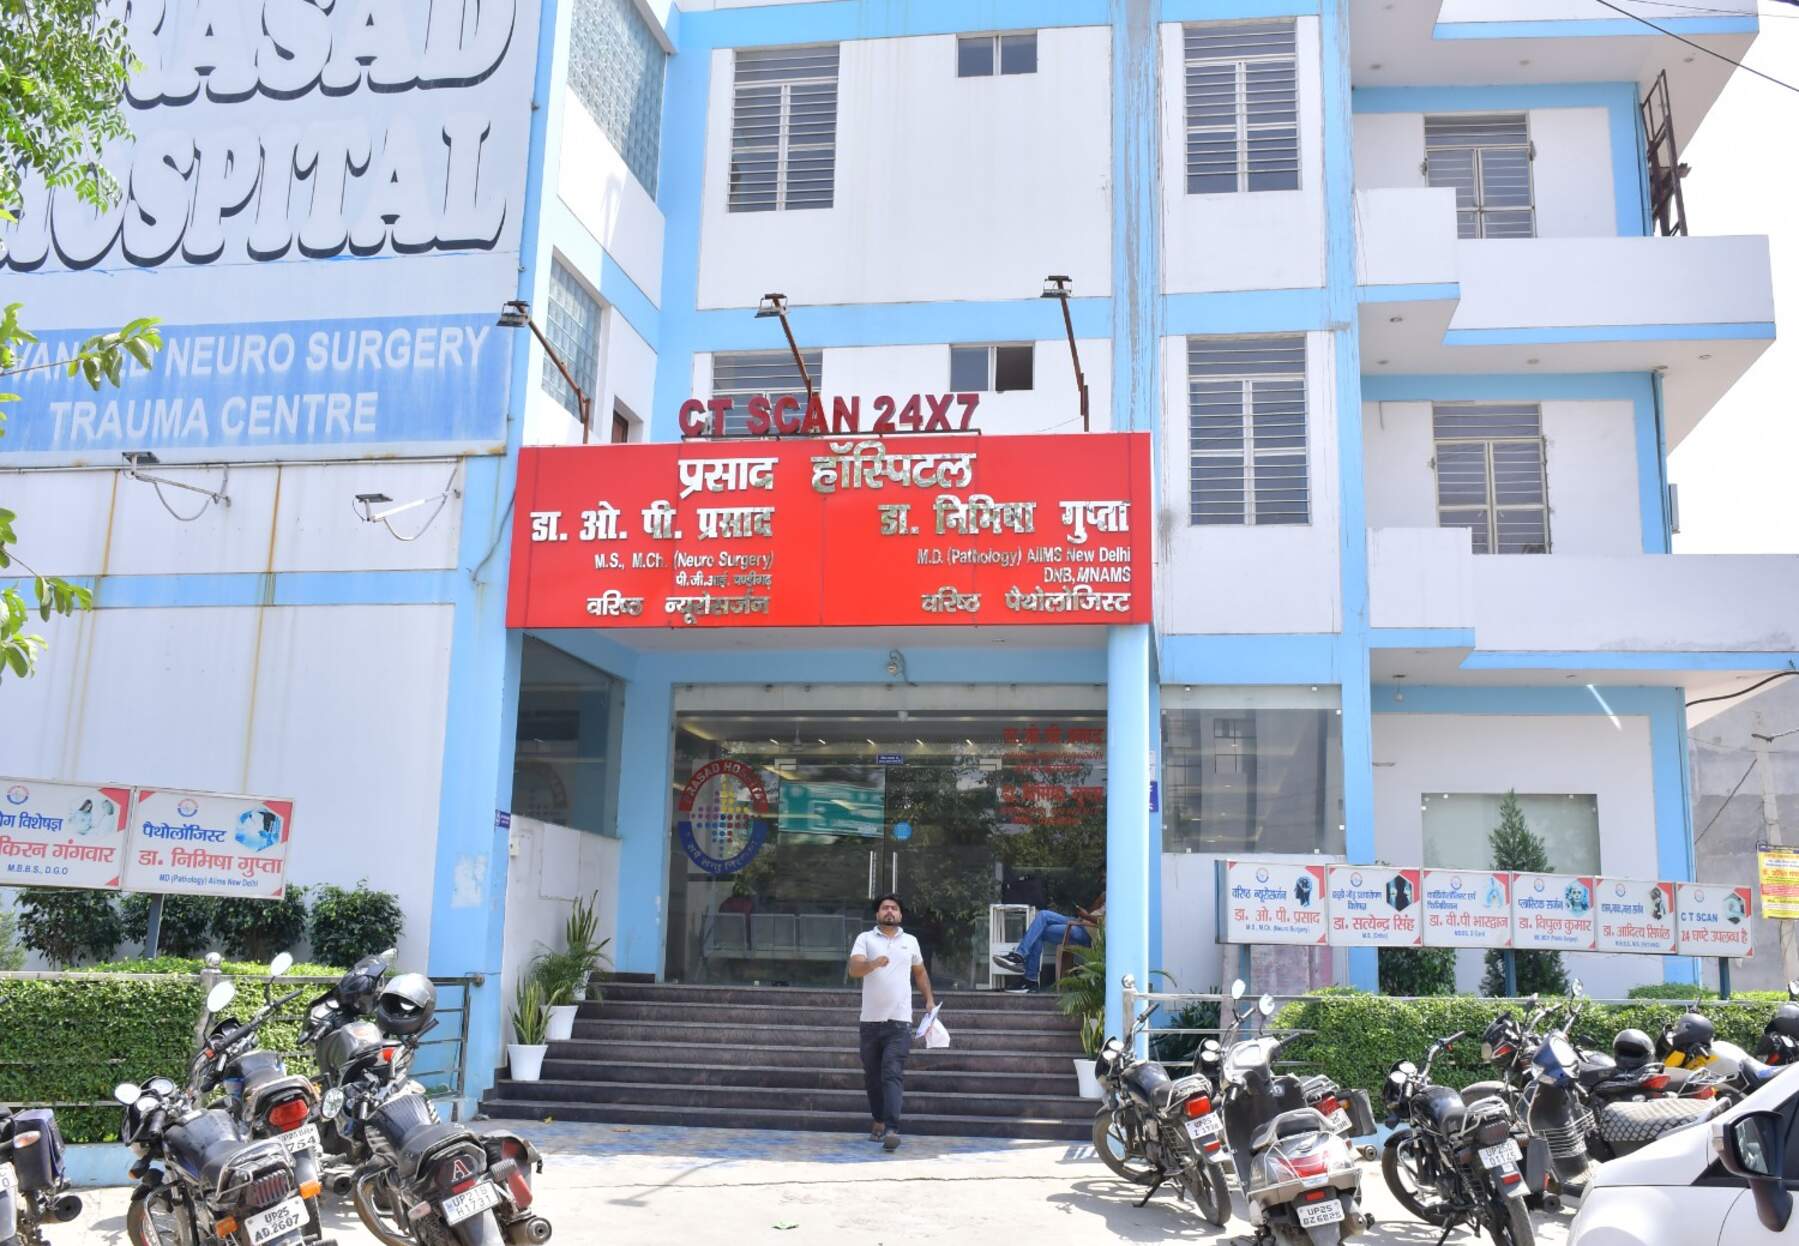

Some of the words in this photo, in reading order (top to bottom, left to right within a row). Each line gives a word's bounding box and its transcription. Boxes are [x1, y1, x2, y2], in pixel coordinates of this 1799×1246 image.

[100, 0, 518, 110] RASAD
[164, 332, 296, 378] NEURO
[304, 325, 492, 374] SURGERY
[49, 397, 209, 442] TRAUMA
[219, 391, 379, 436] CENTRE
[679, 397, 733, 436] CT
[746, 394, 860, 435] SCAN
[872, 392, 980, 433] 24X7
[677, 456, 779, 499] प्रसाद
[810, 439, 977, 493] हॉस्पिटल
[530, 510, 568, 542] डा.
[579, 500, 628, 540] ओ.
[641, 499, 683, 539] पी.
[696, 506, 775, 540] प्रसाद
[878, 503, 919, 535] डा.
[933, 494, 1036, 535] निमिषा
[1059, 500, 1131, 544] गुप्ता
[719, 550, 774, 571] Surgery)
[946, 547, 1022, 567] (Pathology)
[1026, 546, 1063, 564] AIIMS
[1066, 547, 1094, 563] New
[1099, 546, 1131, 563] Delhi
[586, 589, 644, 616] वरिष्ठ
[921, 585, 981, 613] वरिष्ठ
[19, 811, 64, 832] विशेषज्ञ
[52, 839, 117, 863] गंगवार
[138, 849, 163, 867] डा.
[171, 847, 234, 871] निमिषा
[238, 856, 283, 878] गुप्ता
[1293, 911, 1321, 925] प्रसाद
[1393, 914, 1415, 931] सिंह
[1564, 919, 1592, 935] कुमार
[452, 1160, 472, 1183] A
[264, 1205, 290, 1223] UP25
[1306, 1205, 1333, 1216] UP25
